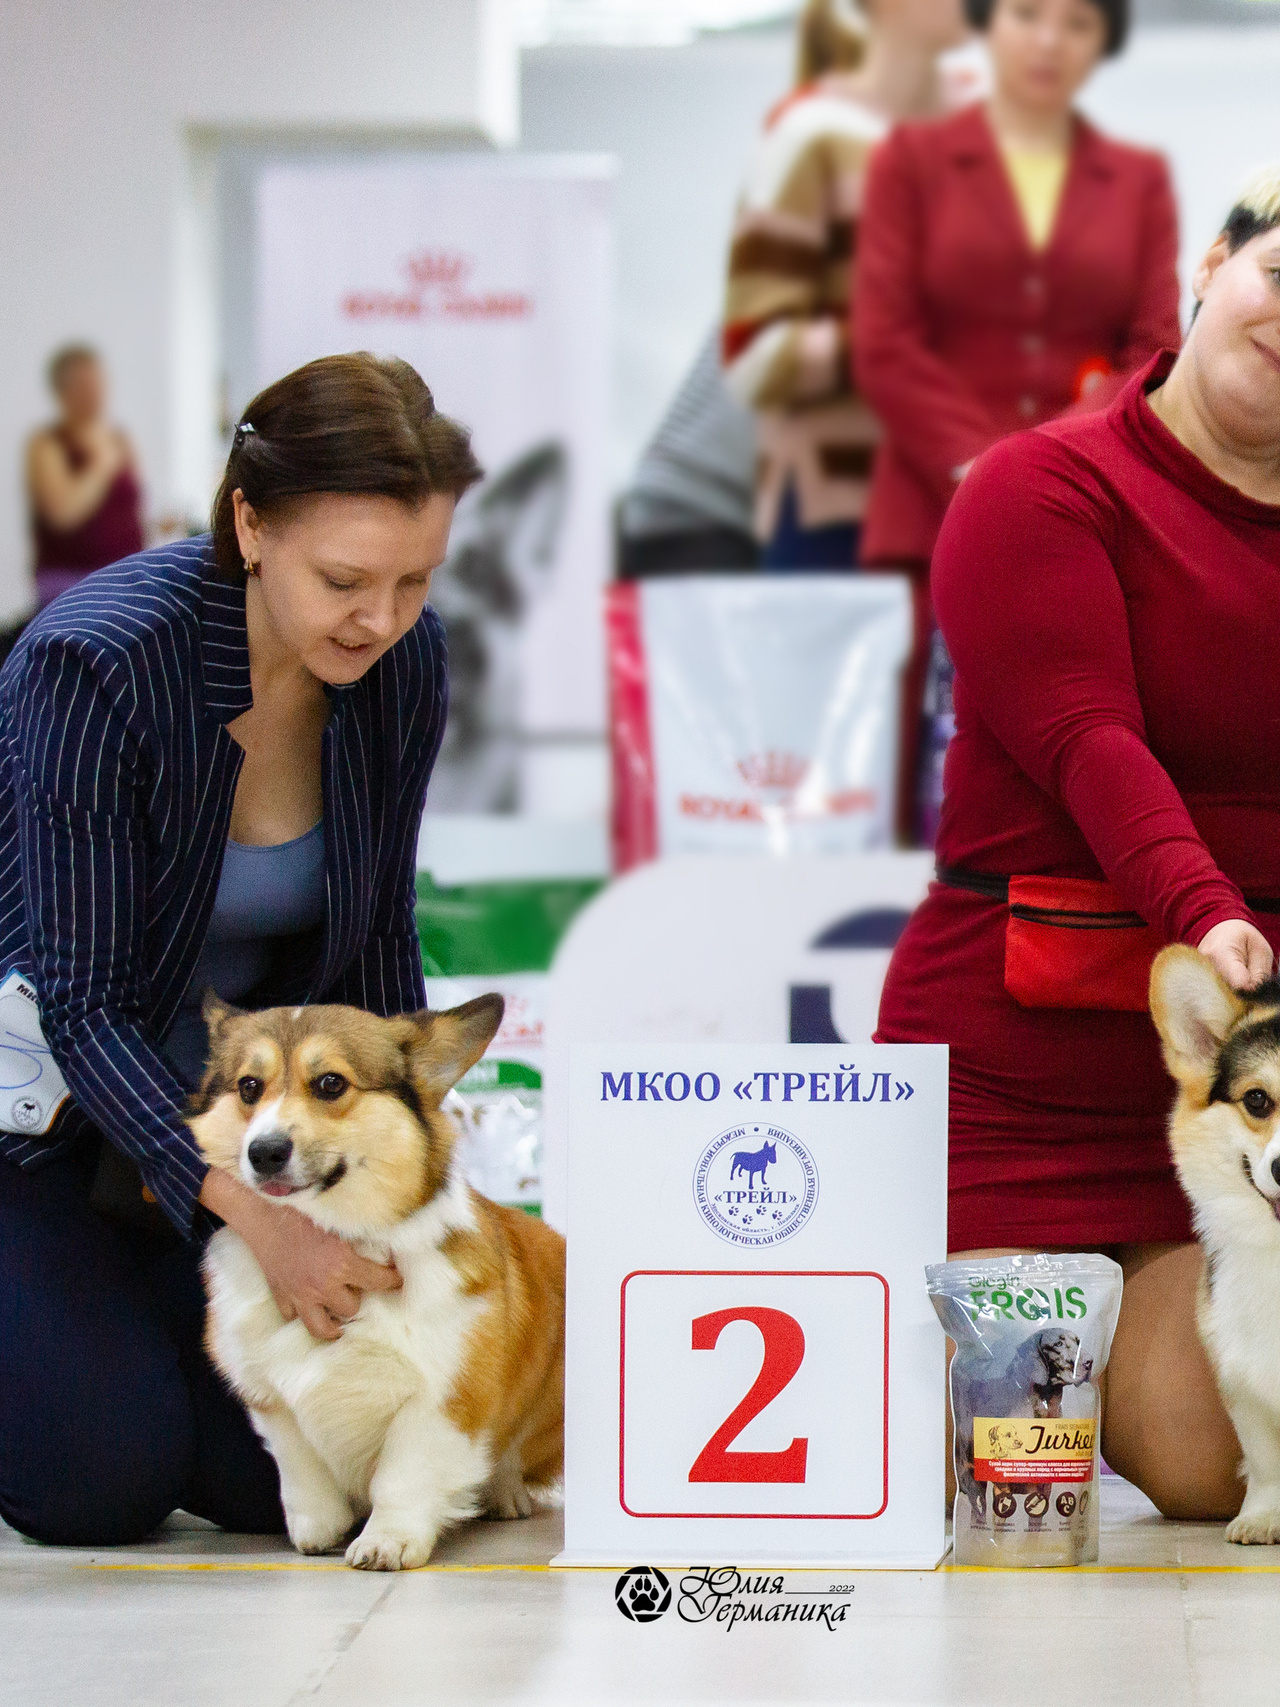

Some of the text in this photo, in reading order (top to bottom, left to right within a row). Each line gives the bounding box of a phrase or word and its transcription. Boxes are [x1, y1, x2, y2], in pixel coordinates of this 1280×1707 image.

[600, 1063, 915, 1103] МКОО «ТРЕЙЛ»
[697, 1127, 815, 1245] МЕЖРЕГИОНАЛЬНАЯ КИНОЛОГИЧЕСКАЯ ОБЩЕСТВЕННАЯ ОРГАНИЗАЦИЯ
[714, 1186, 798, 1204] «ТРЕЙЛ»
[968, 1286, 1088, 1321] FRAIS
[689, 1307, 808, 1483] 2
